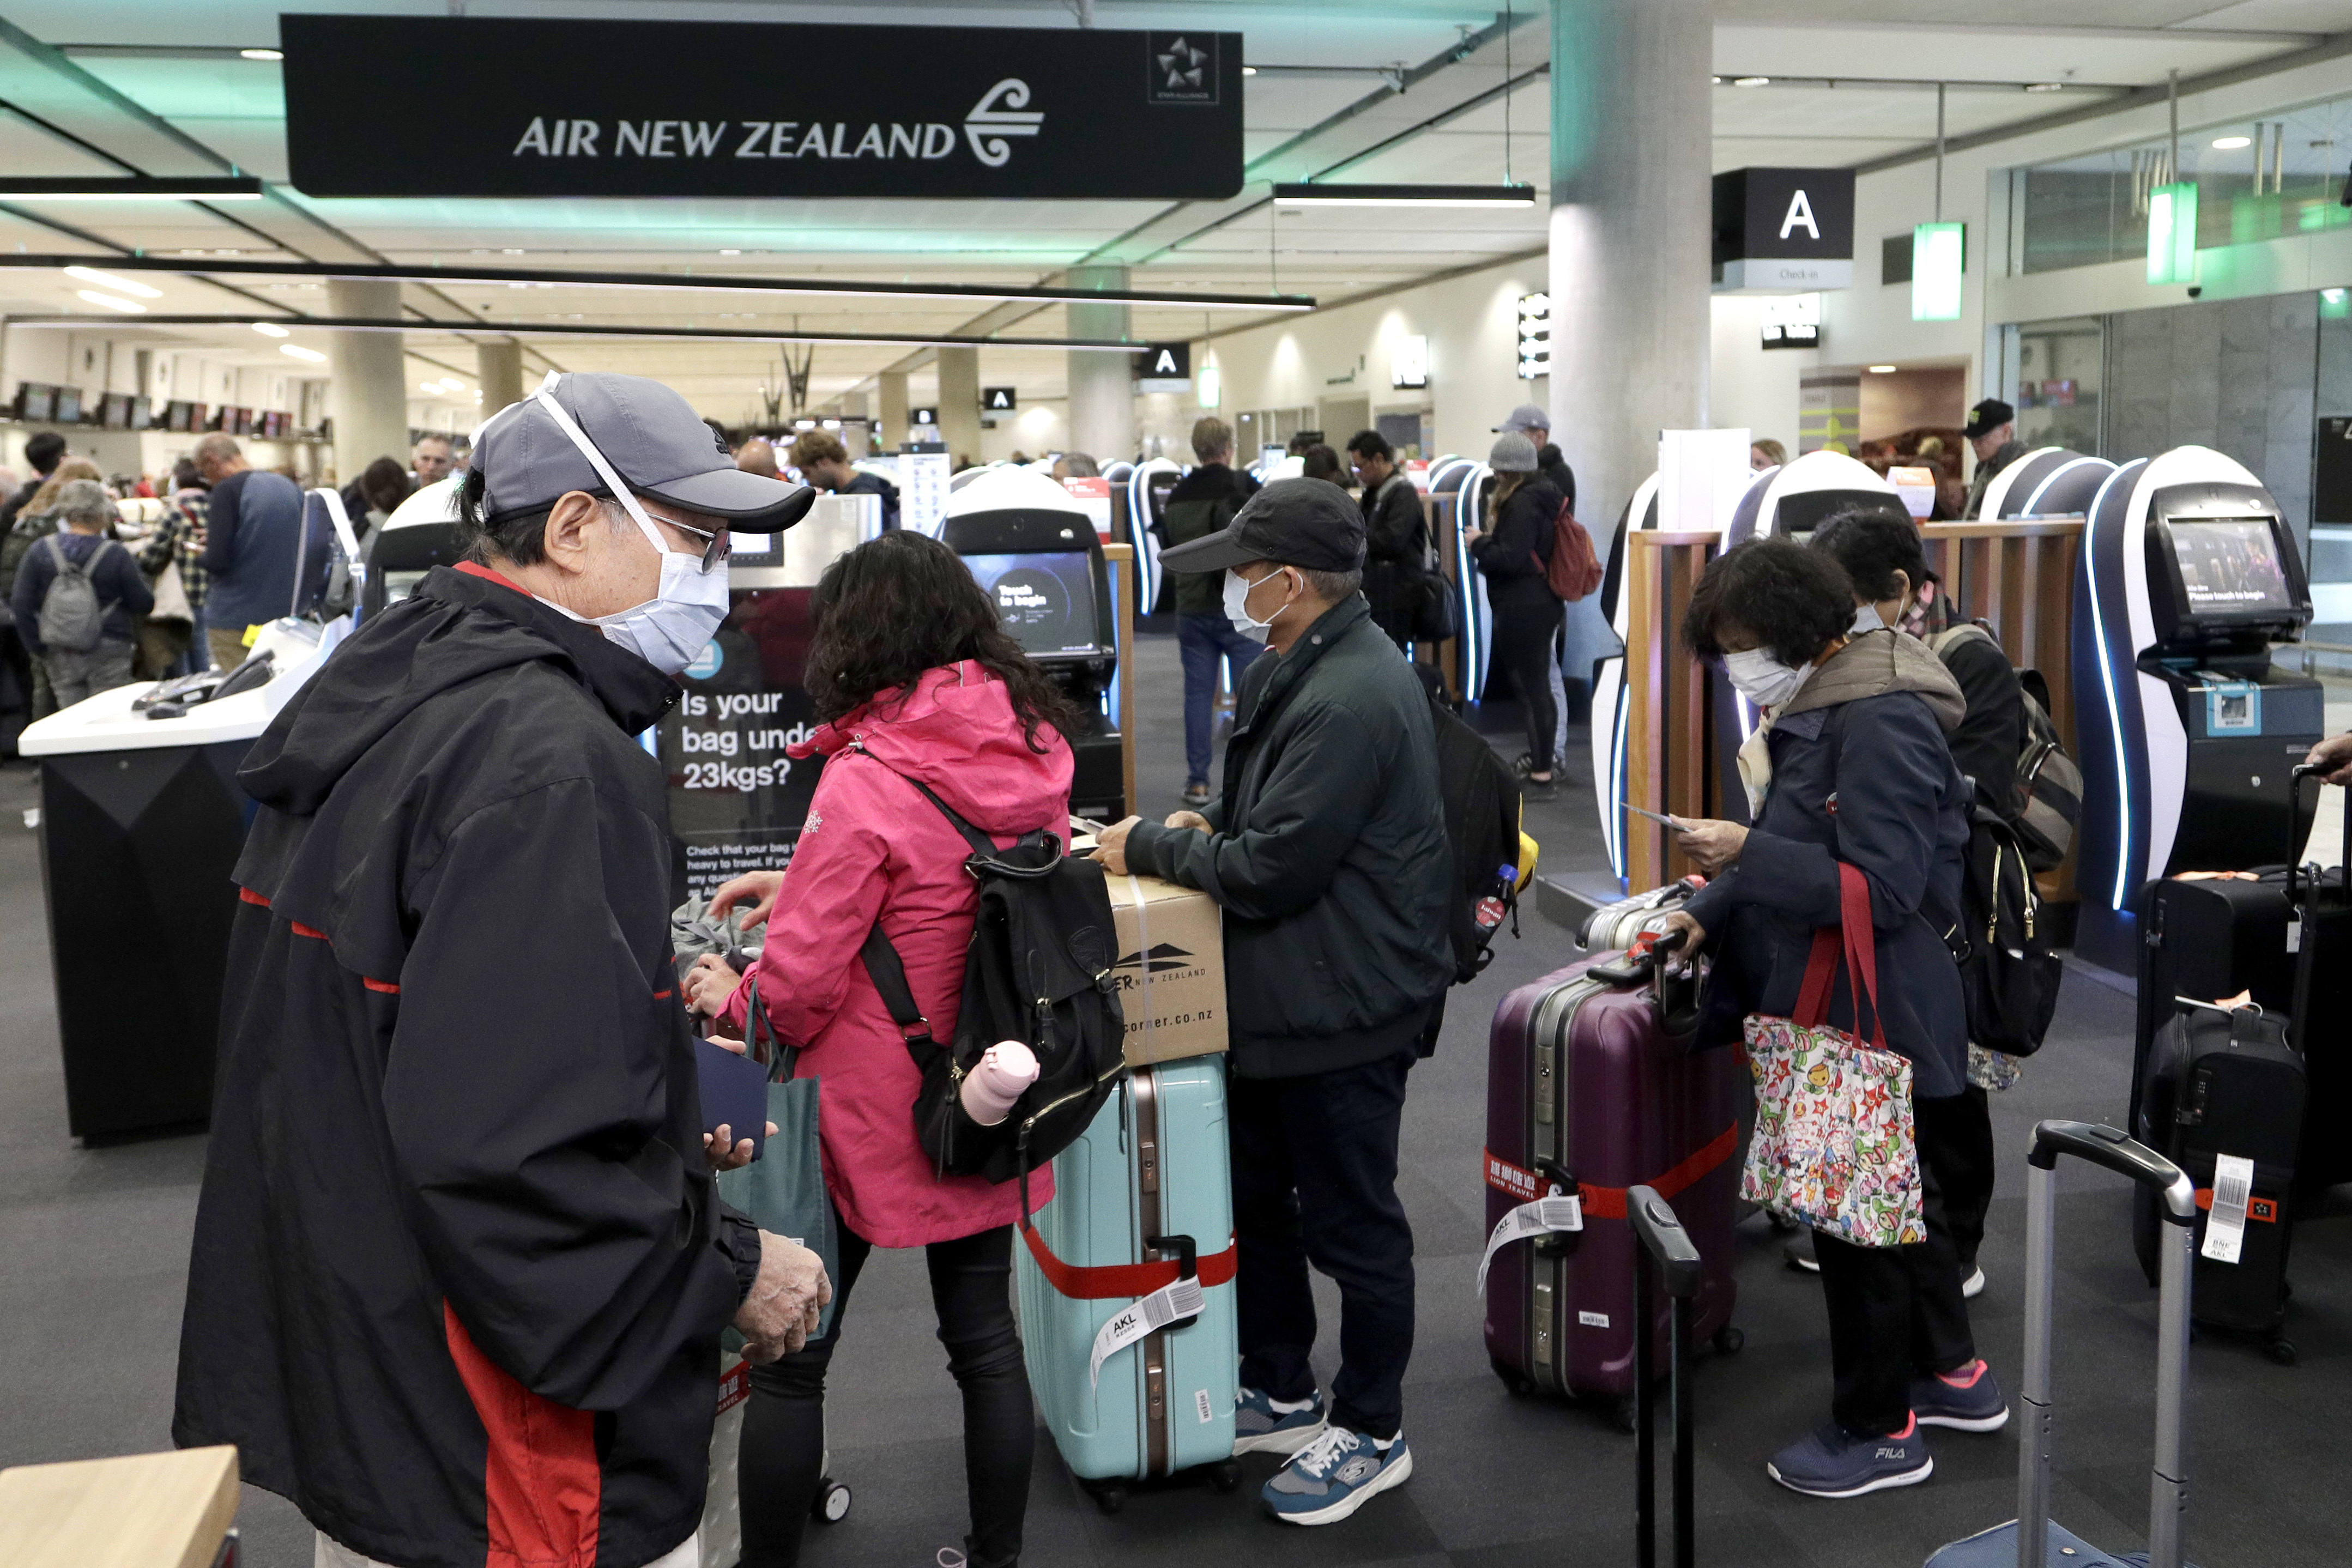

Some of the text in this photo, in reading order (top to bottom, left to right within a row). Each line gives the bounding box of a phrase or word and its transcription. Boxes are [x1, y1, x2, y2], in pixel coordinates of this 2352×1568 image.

[512, 116, 956, 159] AIR NEW ZEALAND
[1780, 190, 1820, 239] A
[1156, 349, 1177, 373] A
[993, 391, 1008, 408] A
[2188, 590, 2266, 601] Please touch to begin
[681, 689, 783, 721] Is your
[682, 726, 738, 756] bag
[683, 758, 791, 792] 23kgs?
[686, 845, 720, 856] Check
[722, 844, 743, 855] that
[745, 845, 768, 855] your
[769, 843, 789, 854] bag
[687, 860, 718, 870] heavy
[719, 859, 731, 868] to
[765, 856, 773, 866] If
[687, 875, 706, 885] any
[1163, 968, 1206, 982] ZEALAND
[1490, 1176, 1535, 1199] LION TRAVEL
[1114, 1313, 1136, 1334] AKL
[1875, 1447, 1905, 1459] FILA
